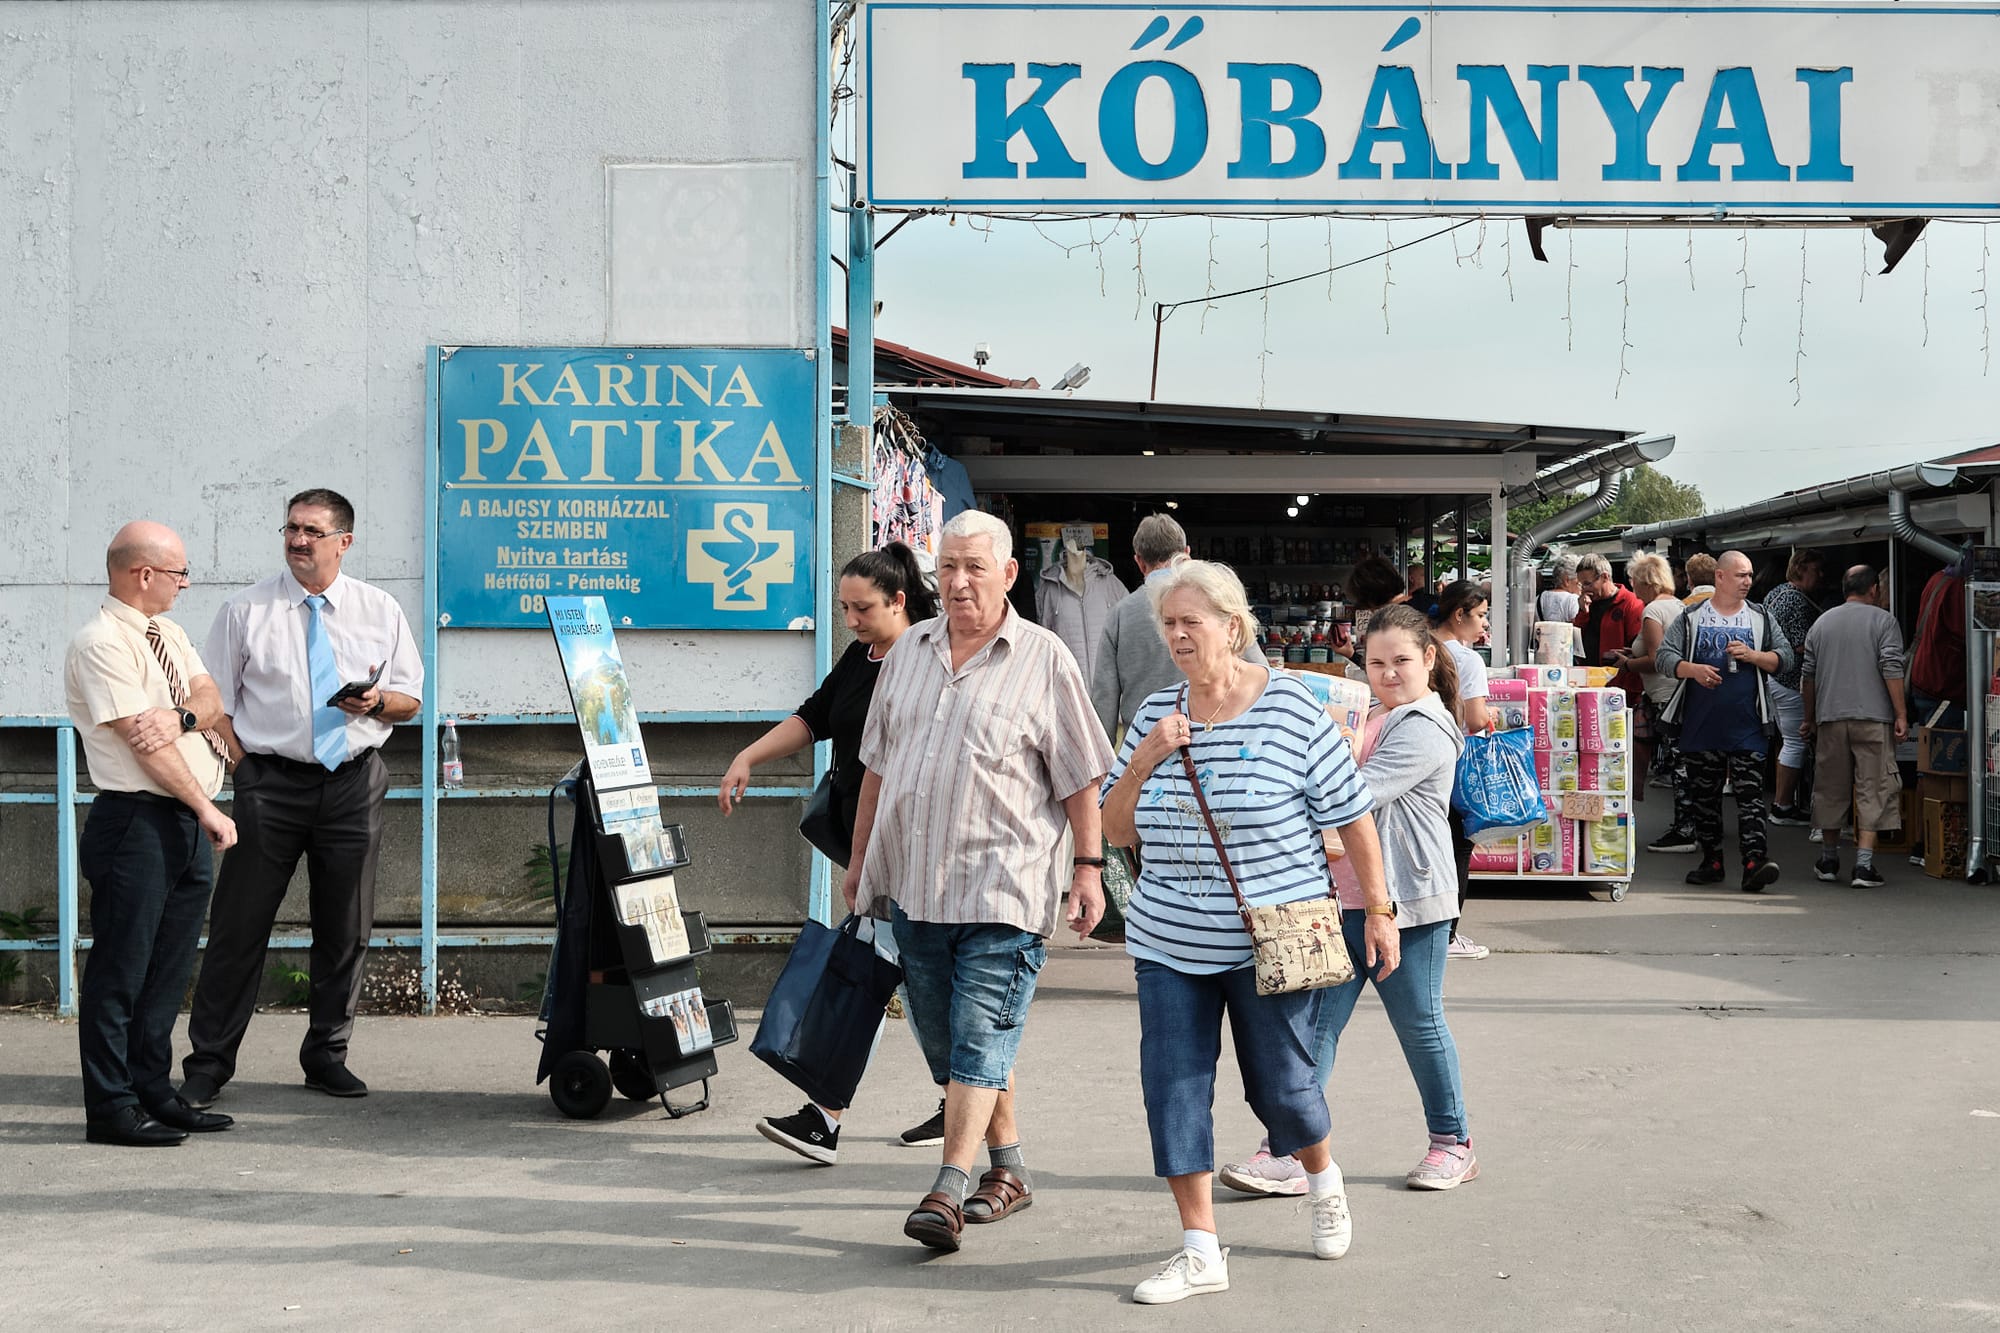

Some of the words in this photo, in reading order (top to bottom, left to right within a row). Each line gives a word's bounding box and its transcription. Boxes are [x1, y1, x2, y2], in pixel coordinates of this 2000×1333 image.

[961, 15, 1854, 183] KŐBÁNYAI
[498, 363, 764, 408] KARINA
[457, 418, 802, 483] PATIKA
[459, 499, 472, 518] A
[478, 499, 552, 518] BAJCSY
[557, 495, 670, 519] KORHÁZZAL
[517, 520, 608, 540] SZEMBEN
[497, 546, 557, 568] Nyitva
[564, 547, 628, 566] tartás:
[484, 572, 550, 590] Hétfőtől
[568, 573, 641, 593] Péntekig
[564, 608, 585, 620] ISTEN
[1539, 706, 1547, 734] ROLLS
